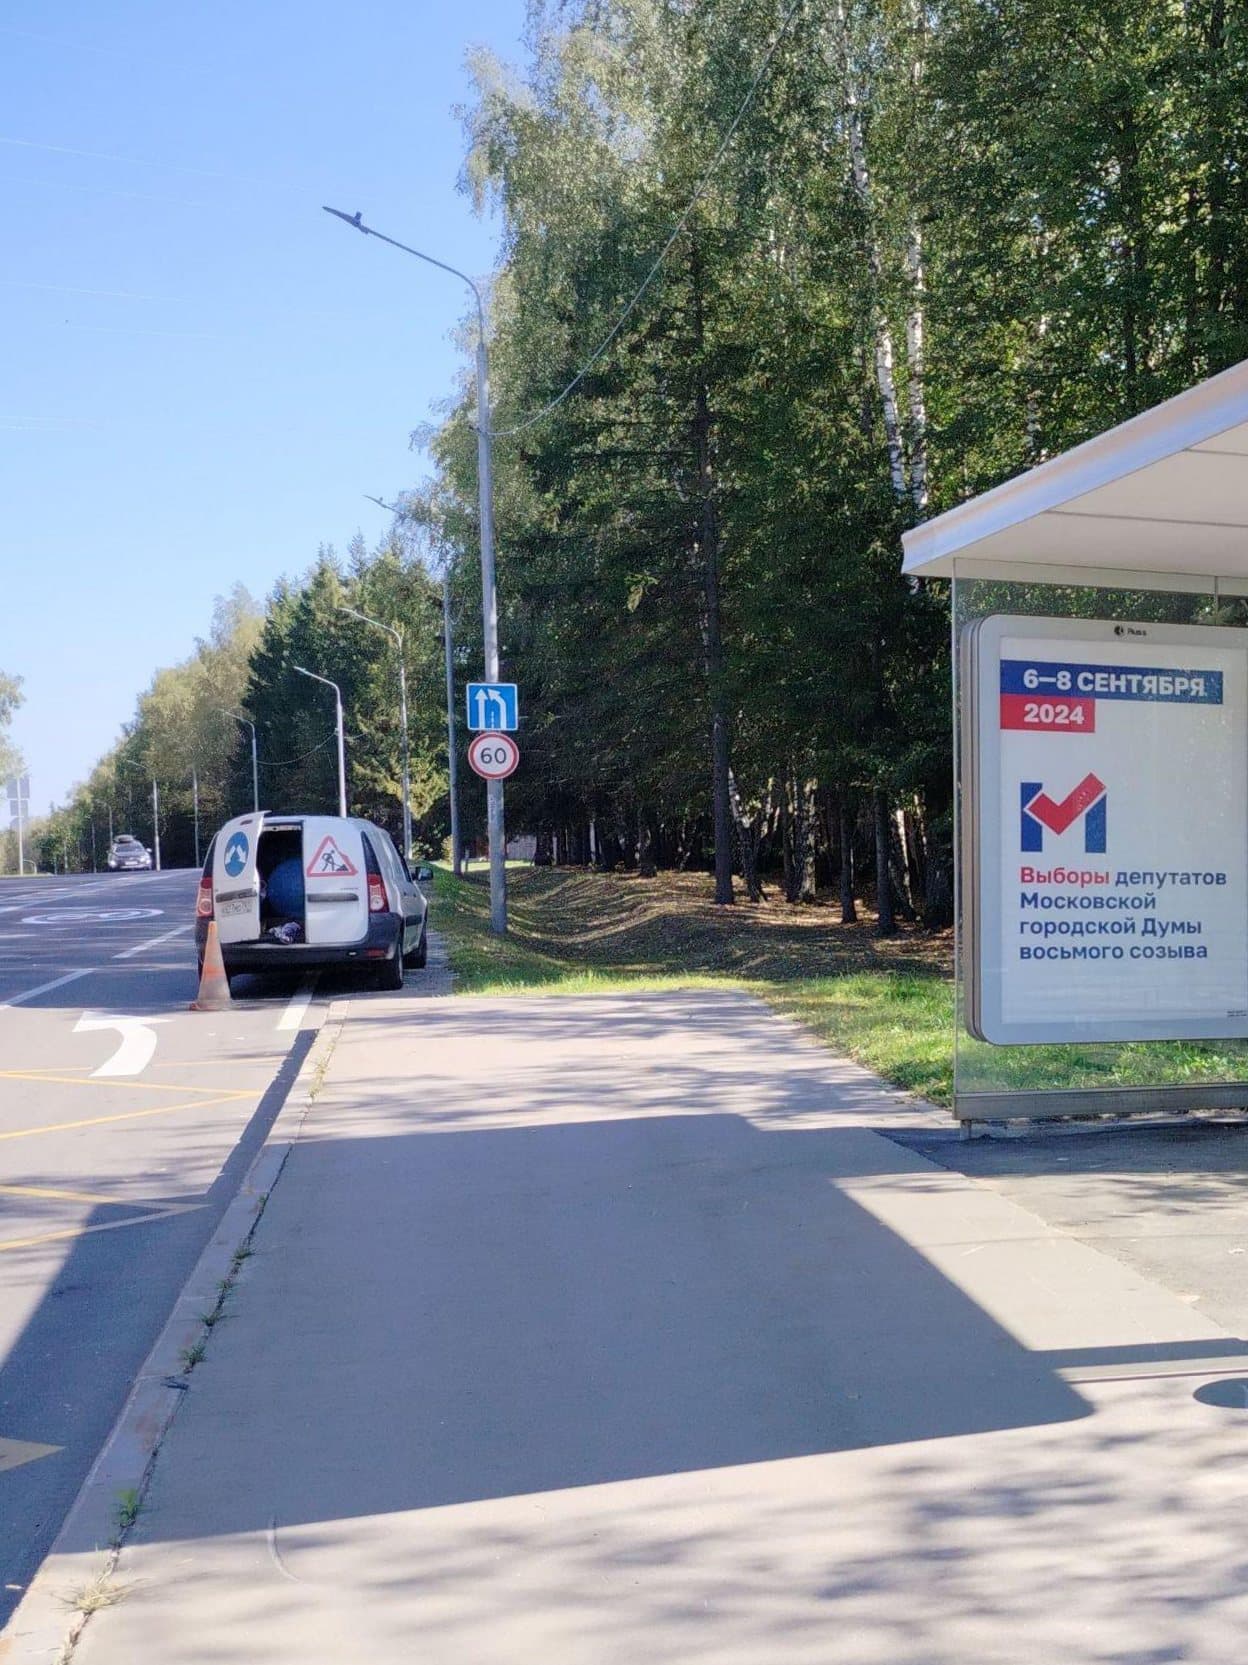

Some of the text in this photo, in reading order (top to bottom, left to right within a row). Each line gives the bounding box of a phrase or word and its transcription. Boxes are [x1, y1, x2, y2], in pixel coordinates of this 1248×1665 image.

[1077, 672, 1206, 697] СЕНТЯБРЯ
[1023, 703, 1085, 725] 2024
[480, 747, 507, 764] 60
[1020, 867, 1227, 889] Выборы депутатов
[1020, 892, 1156, 909] Московской
[1020, 917, 1201, 938] городской Думы
[1020, 945, 1208, 960] восьмого созыва
